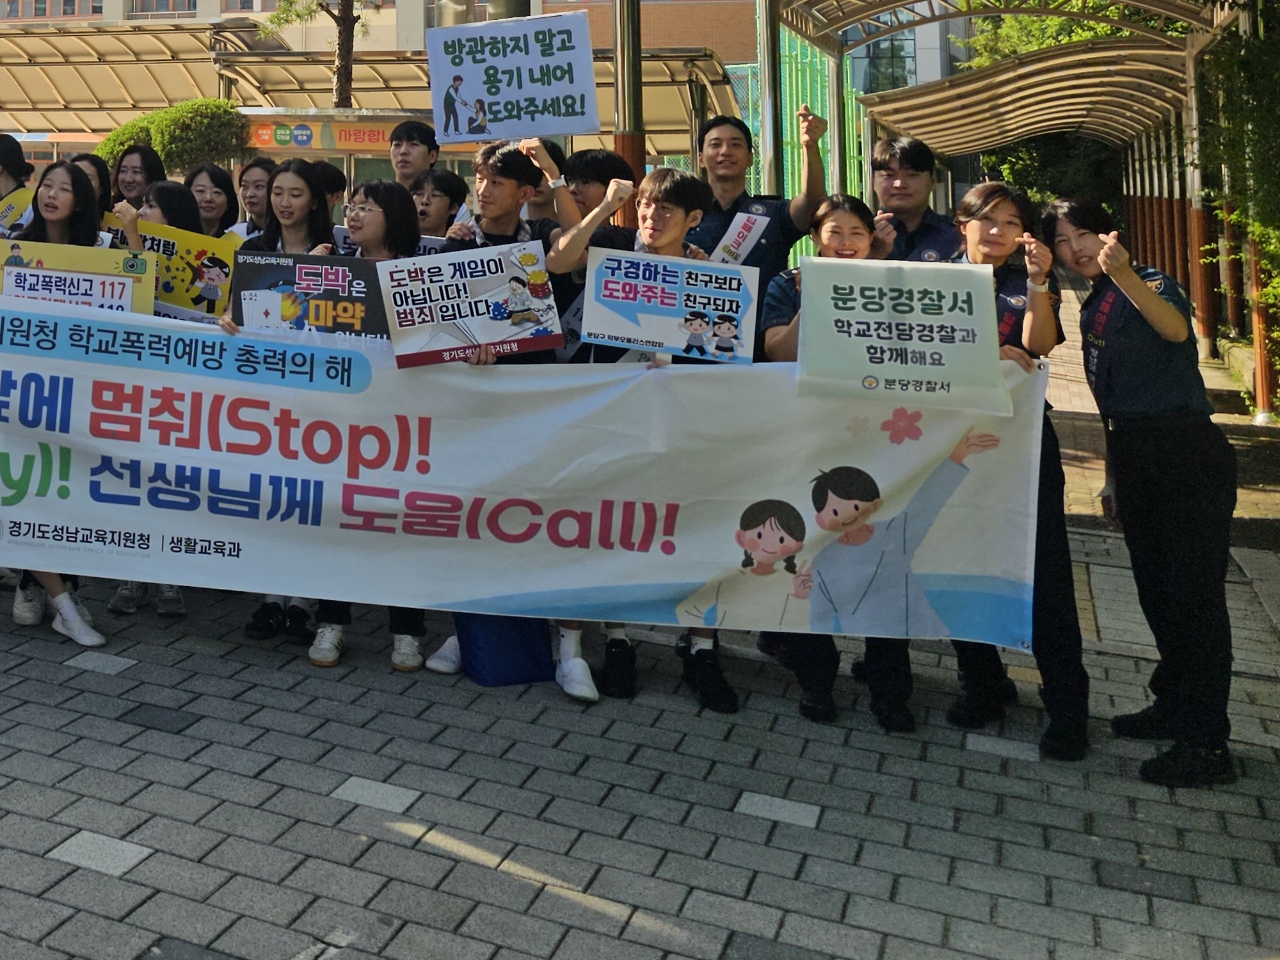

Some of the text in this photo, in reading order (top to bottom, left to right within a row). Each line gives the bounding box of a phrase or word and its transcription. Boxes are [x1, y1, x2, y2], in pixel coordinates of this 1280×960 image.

[443, 28, 576, 67] 방관하지 말고
[483, 62, 574, 96] 용기 내어
[487, 93, 586, 123] 도와주세요!
[236, 254, 294, 266] 경기도성남교육지원청
[388, 257, 505, 289] 도박은 게임이
[604, 257, 743, 292] 구경하는 친구보다
[14, 271, 94, 297] 학교폭력신고
[99, 280, 126, 301] 117
[295, 264, 367, 297] 도박은
[392, 282, 470, 308] 아닙니다!
[601, 279, 742, 315] 도와주는 친구되자
[830, 283, 975, 316] 분당경찰서
[308, 299, 366, 330] 마약
[395, 299, 493, 328] 범죄 입니다
[586, 331, 606, 339] 분당구
[833, 317, 978, 345] 학교전담경찰과
[68, 323, 227, 371] 학교폭력예방
[234, 344, 315, 382] 총력의
[325, 355, 353, 387] 해
[865, 344, 946, 367] 함께해요
[883, 377, 951, 393] 분당경찰서
[88, 379, 432, 480] 멈춰(Stop)!
[88, 454, 324, 527] 선생님께
[339, 482, 680, 556] 도움(Call)!
[8, 520, 150, 550] 경기도성남교육지원청
[169, 535, 242, 559] 생활교육과
